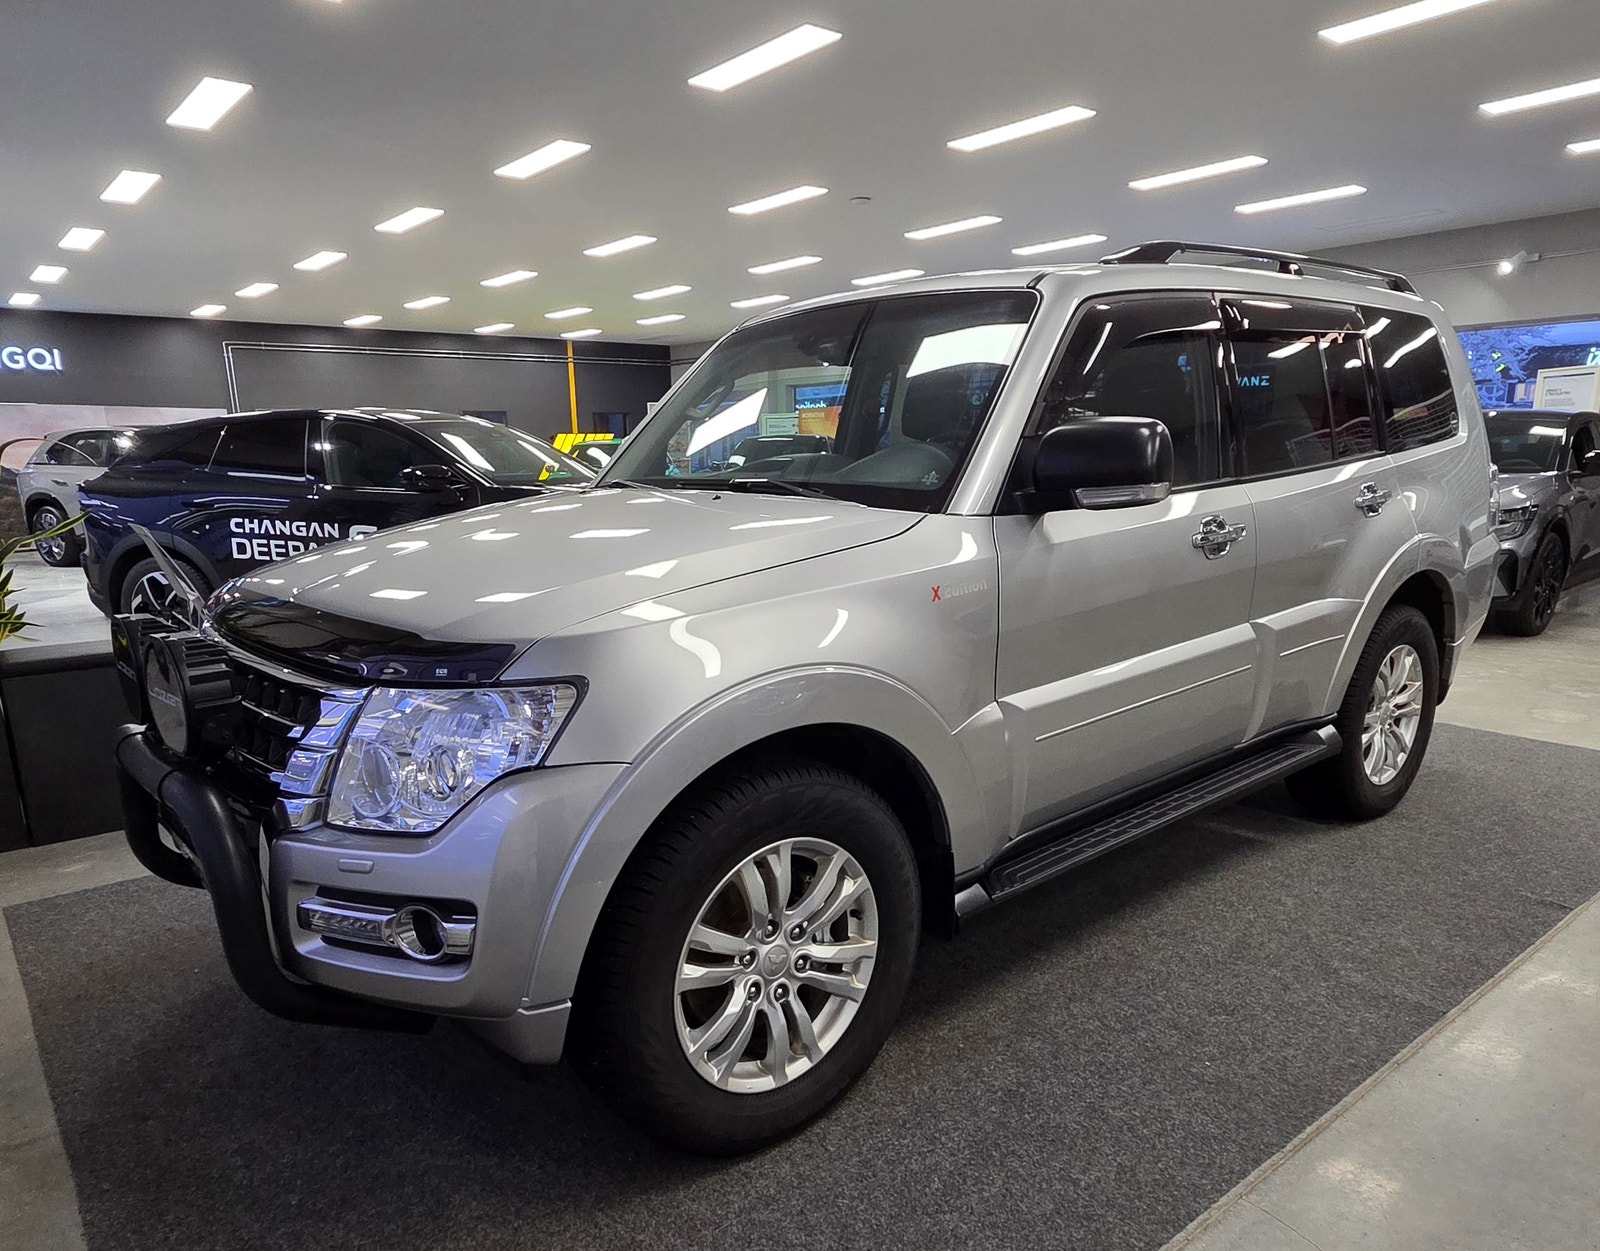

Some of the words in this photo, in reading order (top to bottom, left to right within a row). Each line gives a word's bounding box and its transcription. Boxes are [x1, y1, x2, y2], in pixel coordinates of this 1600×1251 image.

[0, 346, 63, 371] GQI
[229, 517, 340, 539] CHANGAN
[931, 585, 942, 602] X
